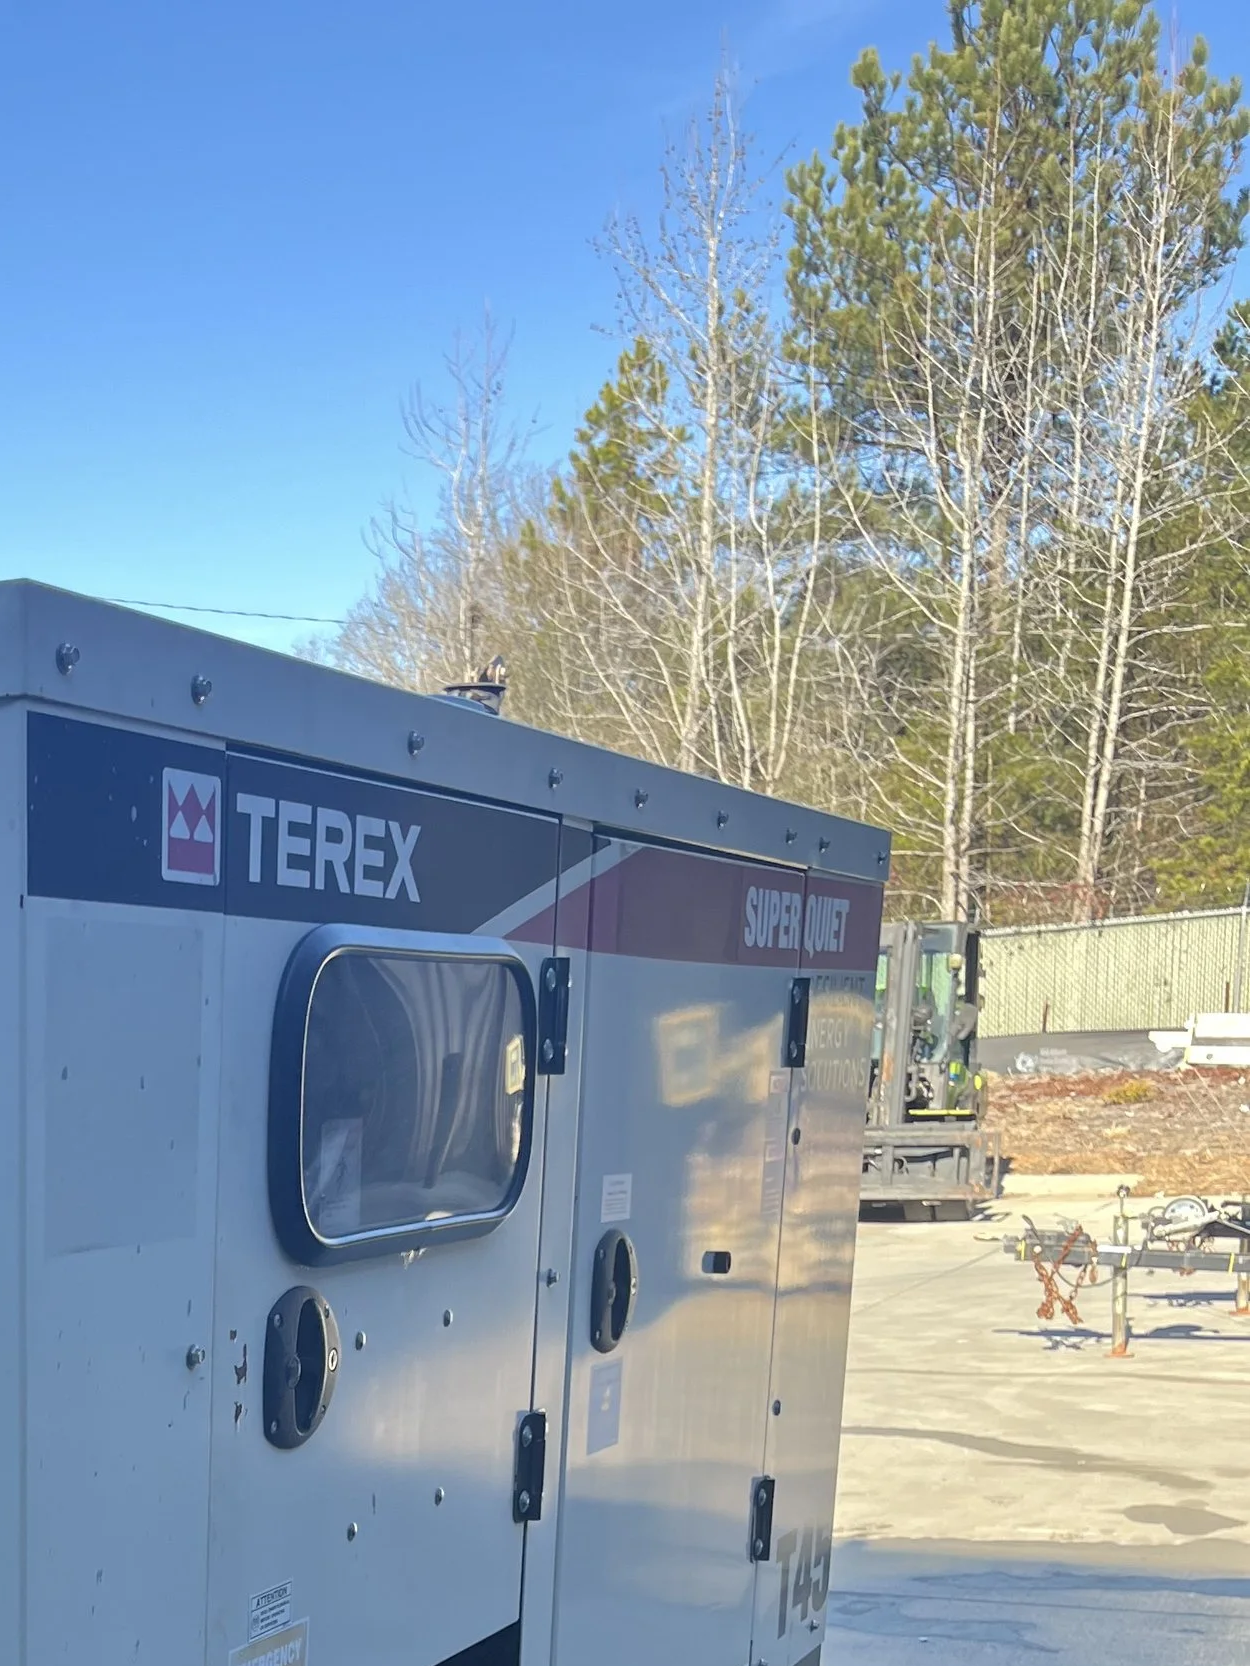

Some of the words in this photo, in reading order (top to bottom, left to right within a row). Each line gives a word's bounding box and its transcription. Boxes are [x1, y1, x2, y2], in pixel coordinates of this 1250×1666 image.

[236, 792, 422, 903] TEREX
[743, 885, 801, 951] SUPER
[803, 892, 850, 960] QUIET
[808, 1017, 848, 1052] NERGY
[255, 1585, 288, 1609] ATTENTION
